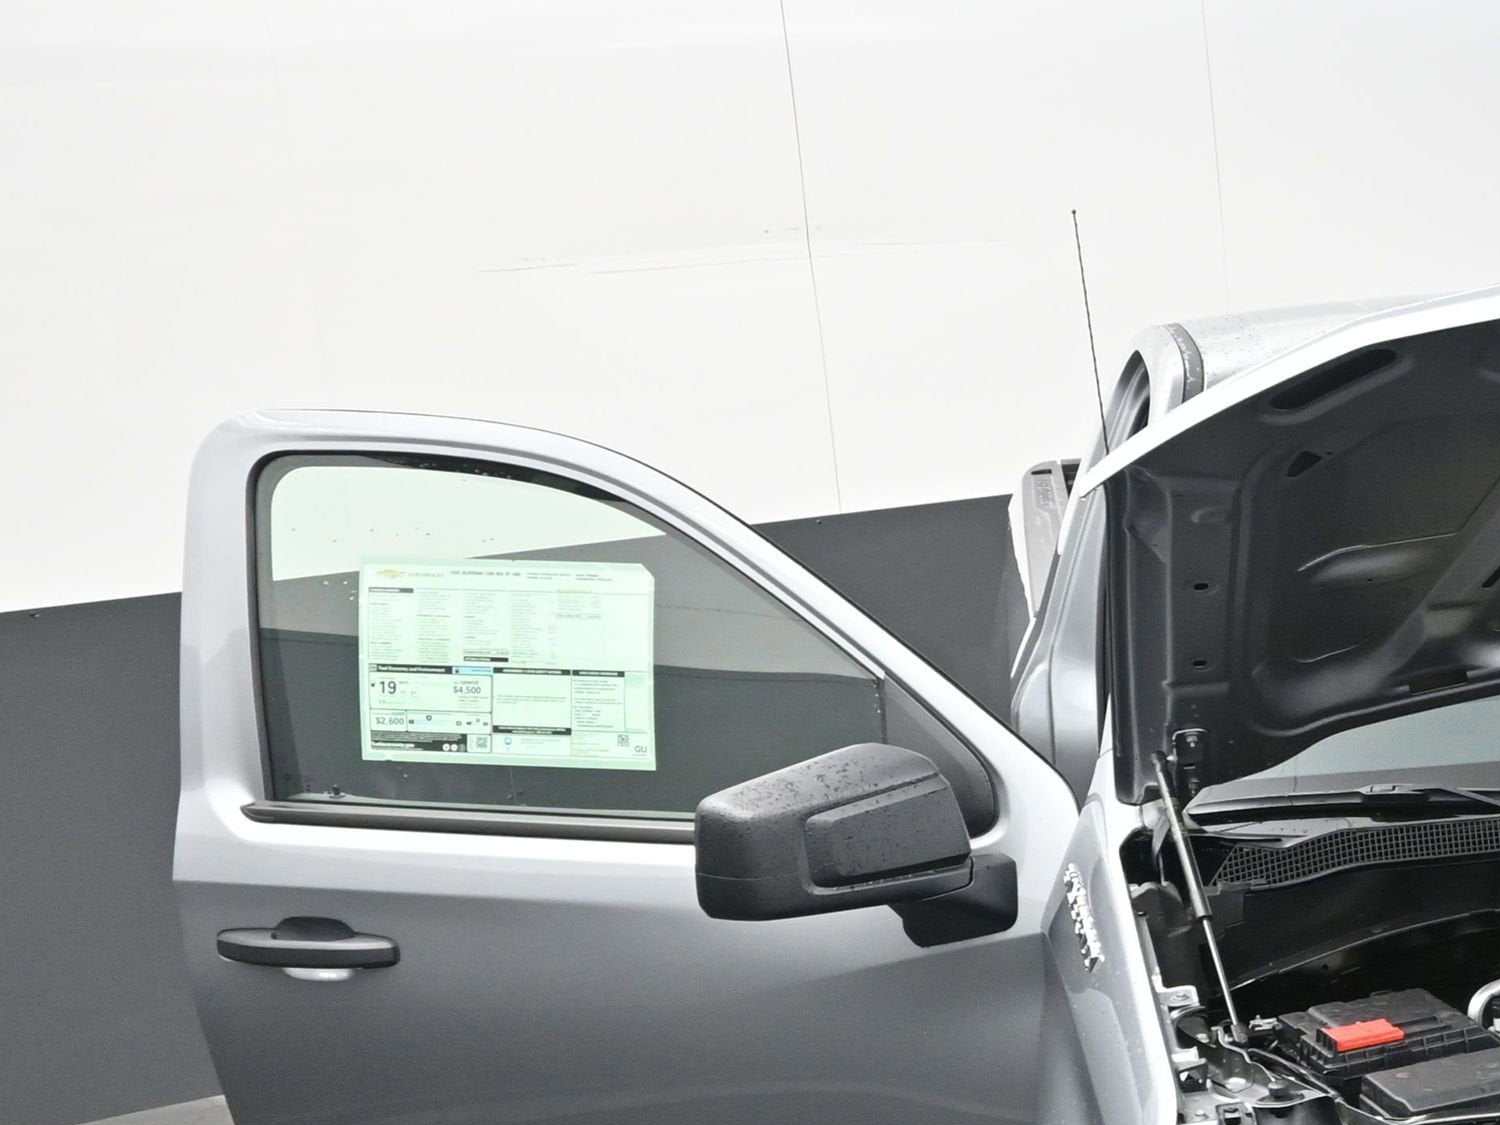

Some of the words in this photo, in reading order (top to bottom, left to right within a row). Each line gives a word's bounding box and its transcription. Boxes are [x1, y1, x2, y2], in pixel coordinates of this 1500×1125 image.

[379, 681, 397, 695] 19
[453, 686, 482, 695] $4,500
[375, 717, 405, 726] $2,600
[634, 745, 648, 753] GU
